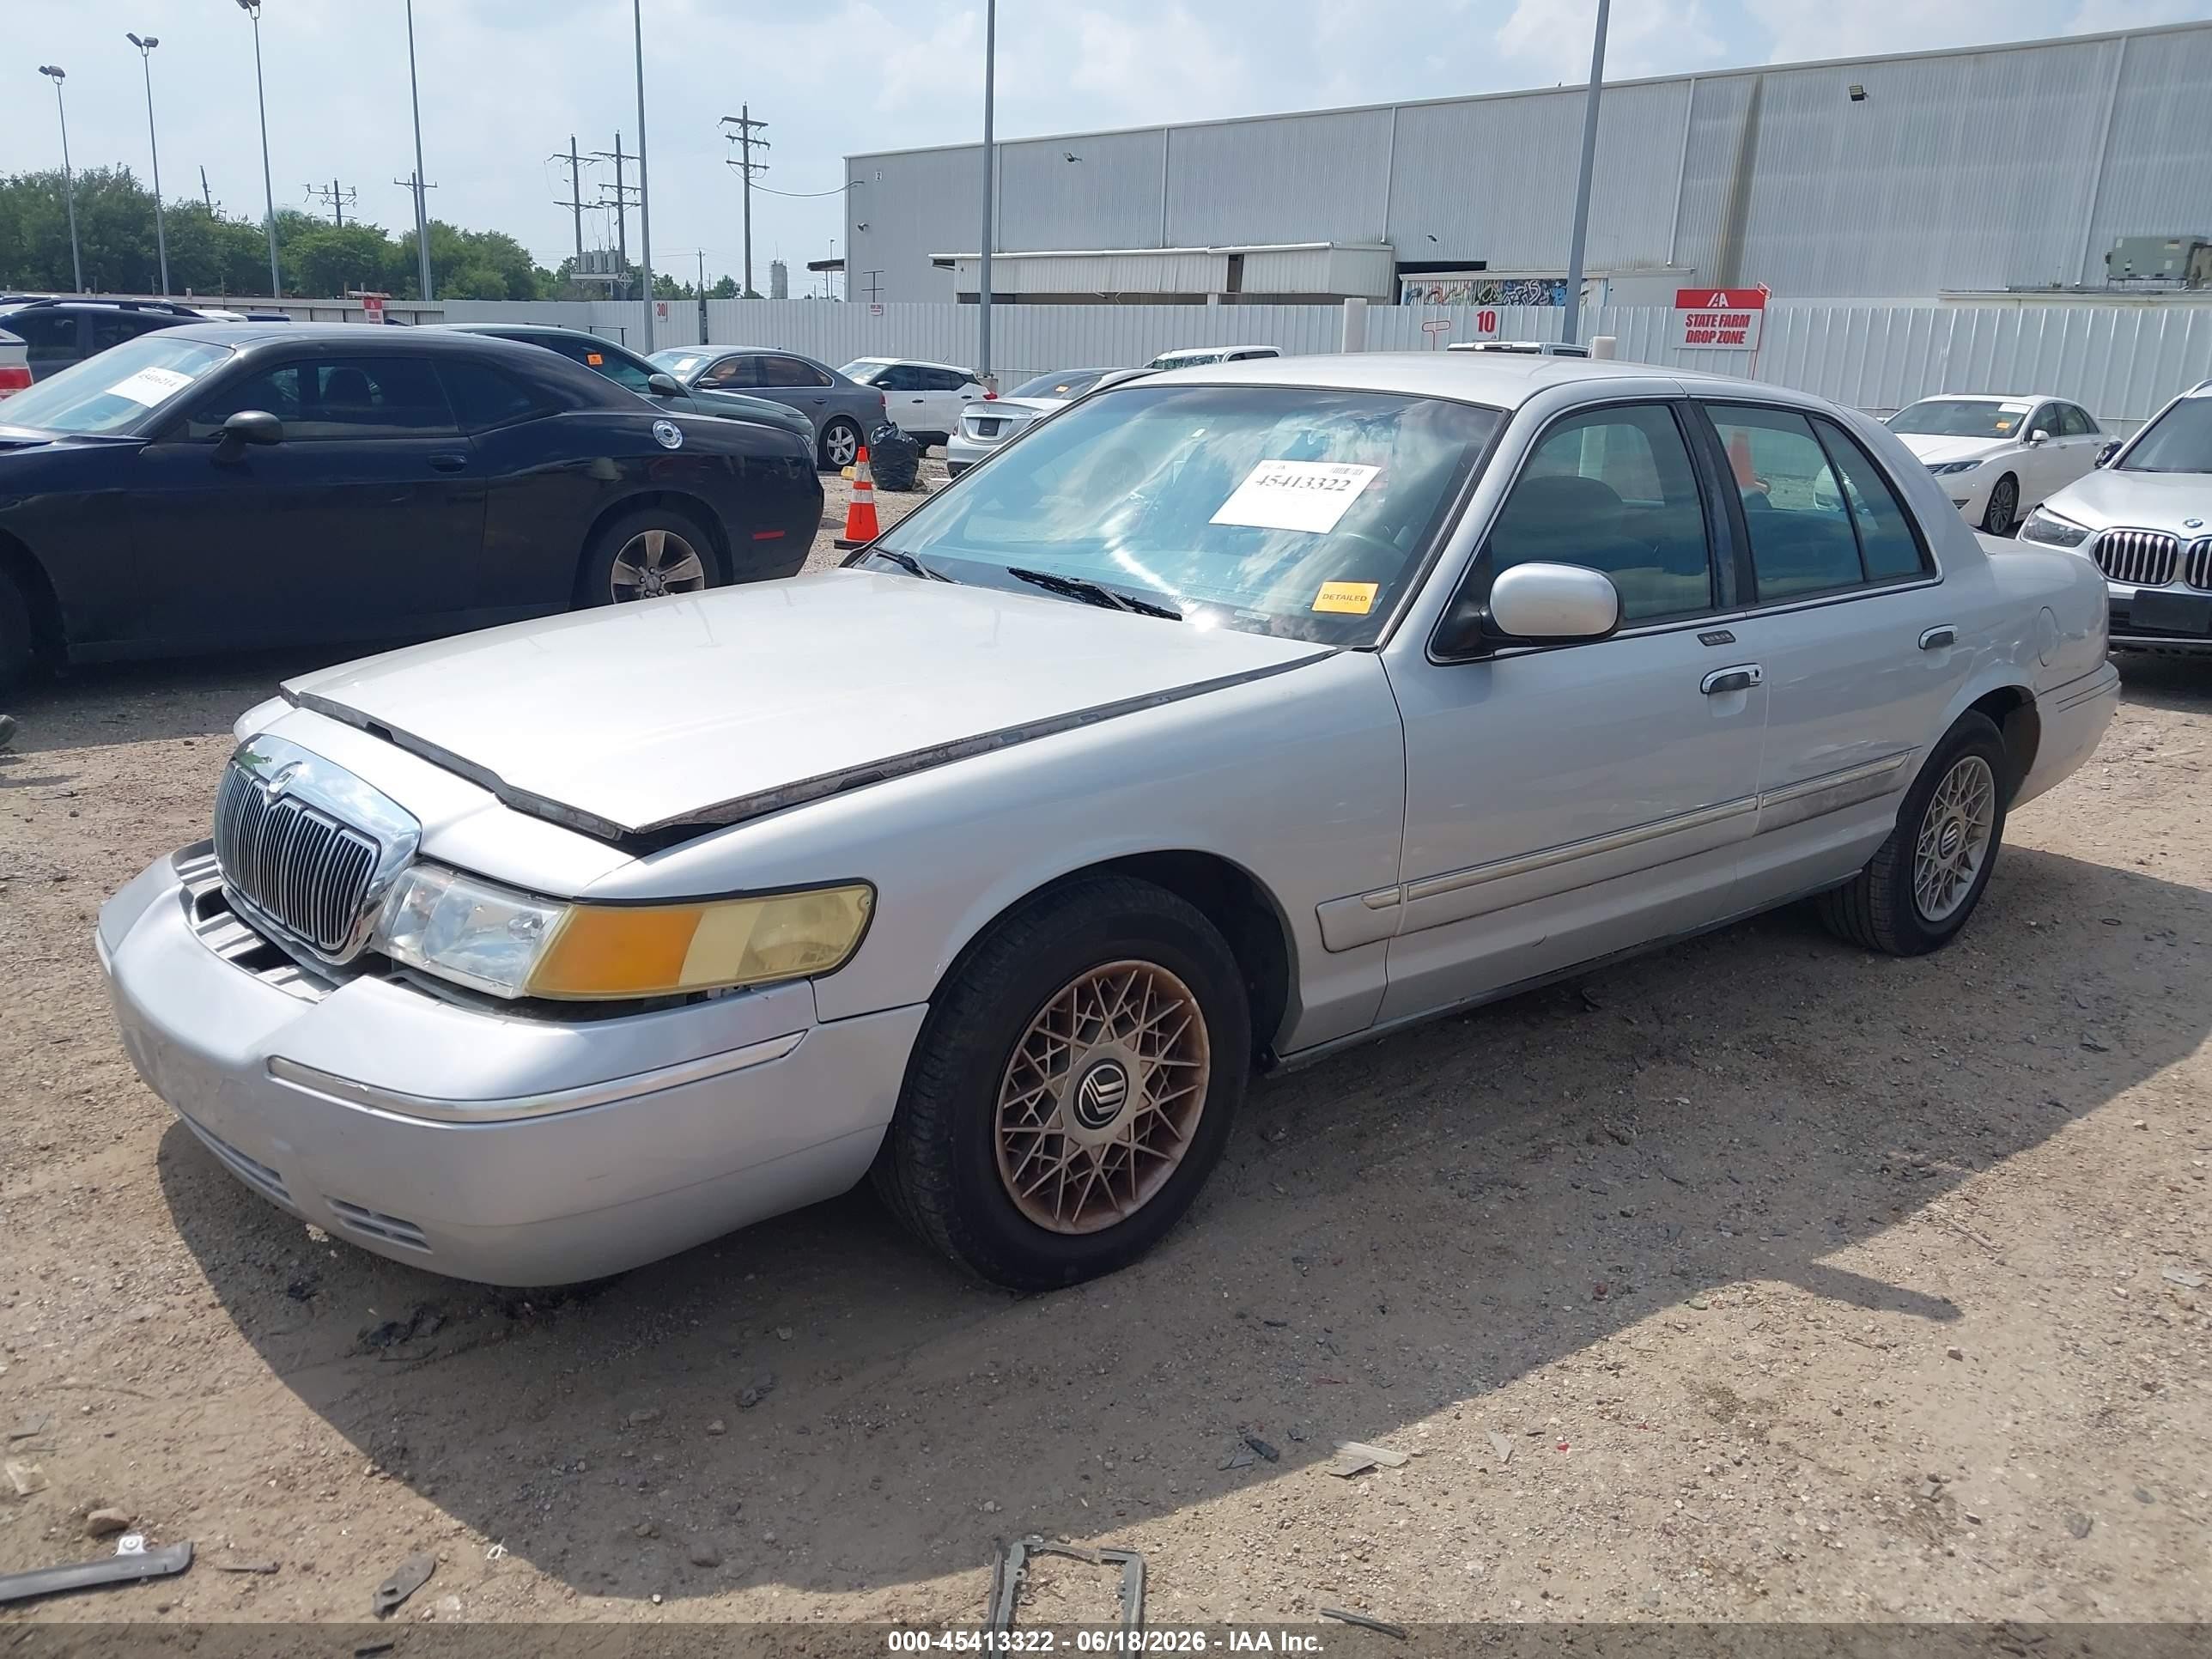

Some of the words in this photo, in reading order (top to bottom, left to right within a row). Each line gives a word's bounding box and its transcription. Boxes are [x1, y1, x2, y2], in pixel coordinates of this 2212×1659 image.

[656, 302, 665, 317] 30
[1477, 310, 1496, 332] 10
[1686, 314, 1718, 327] STATE
[1718, 314, 1751, 328] FARM
[1686, 330, 1717, 343] DROP
[1717, 331, 1746, 344] ZONE
[1255, 474, 1351, 491] 45413322
[1322, 593, 1367, 602] DETAILED
